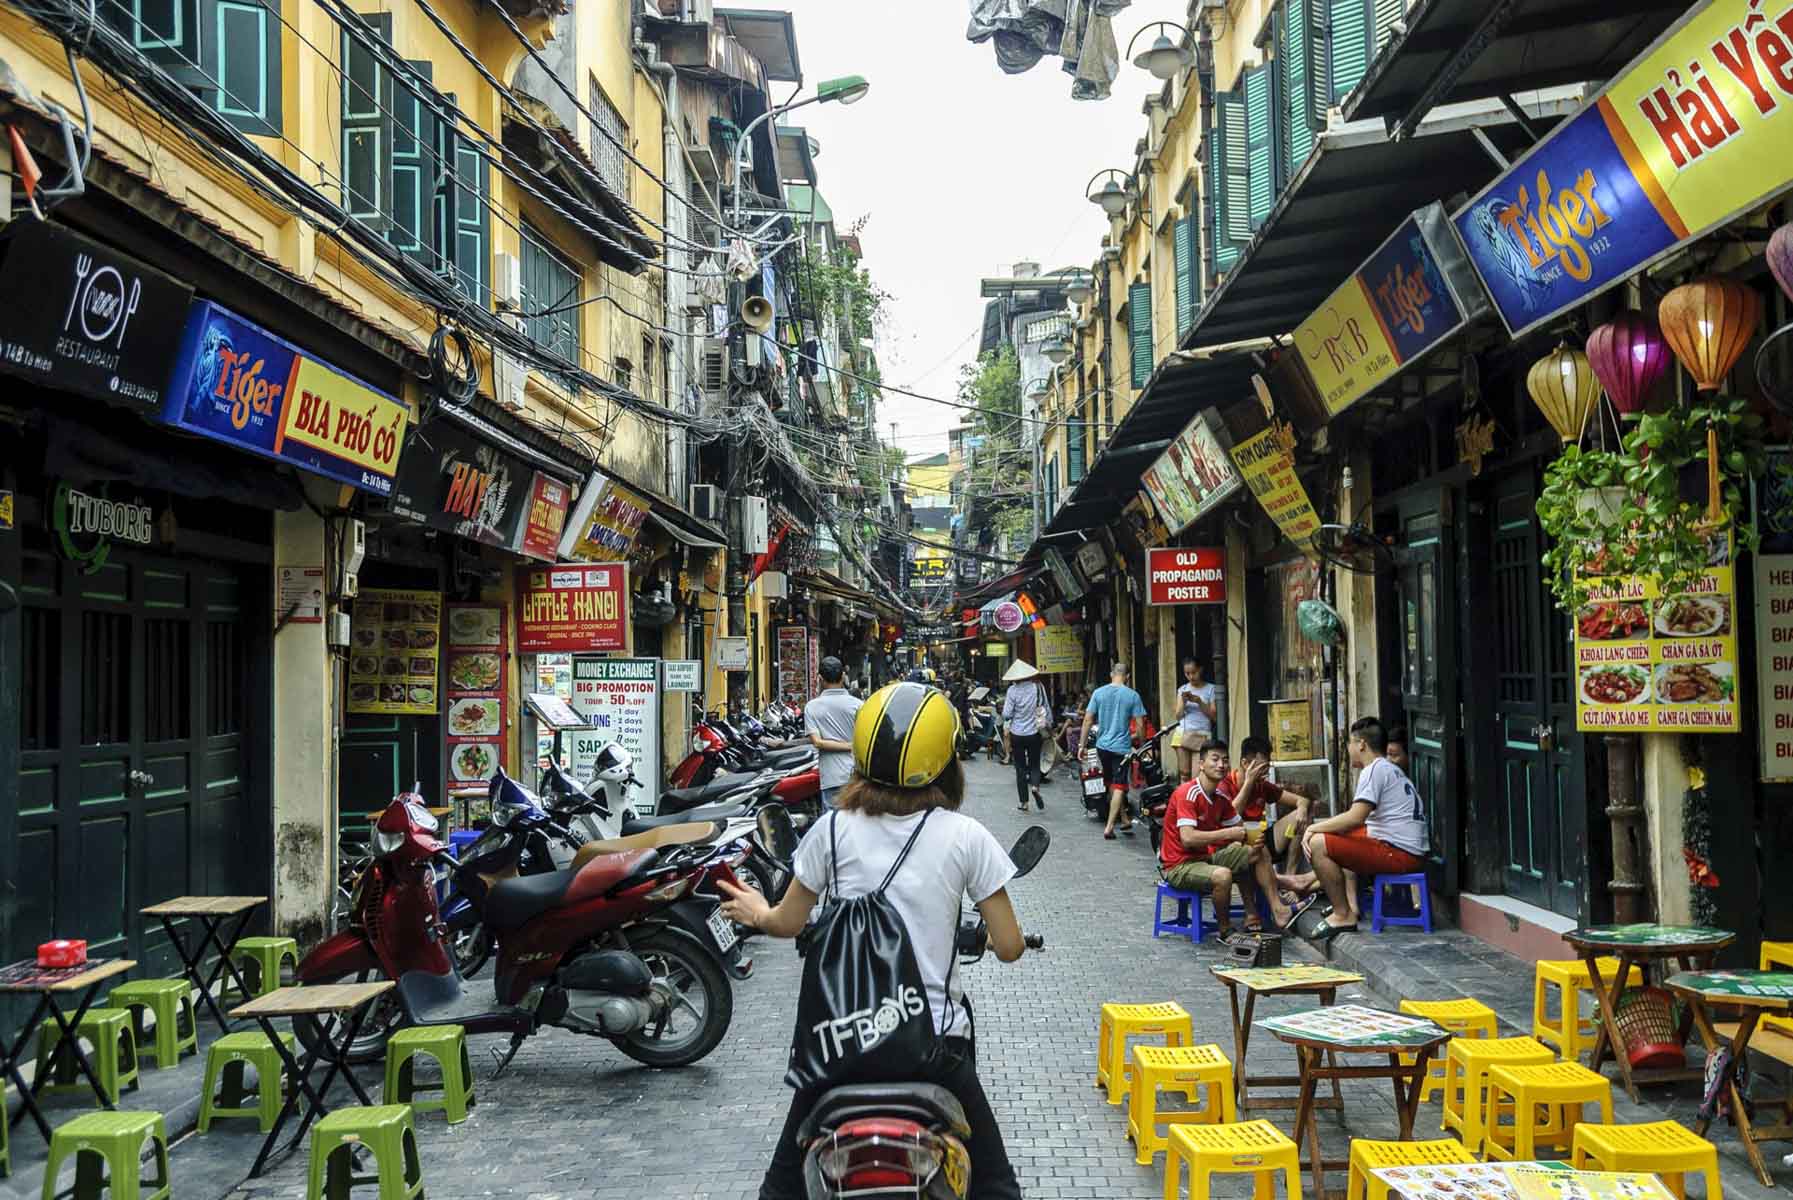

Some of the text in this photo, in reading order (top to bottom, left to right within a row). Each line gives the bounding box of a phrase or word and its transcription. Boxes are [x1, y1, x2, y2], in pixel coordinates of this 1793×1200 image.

[1639, 62, 1742, 168] Hải
[1497, 168, 1613, 282] Tiger
[1376, 264, 1432, 334] Tiger
[55, 336, 120, 372] RESTAURANT
[214, 346, 281, 430] Tiger
[294, 389, 401, 464] BIA PHỐ CỔ
[68, 489, 152, 543] TUBORG
[1175, 553, 1198, 566] OLD
[1153, 568, 1223, 583] PROPAGANDA
[1769, 569, 1793, 586] HE
[1168, 586, 1209, 600] POSTER
[523, 590, 619, 623] LITTLE HANOI
[1580, 647, 1603, 662] KHOAI
[1605, 647, 1625, 660] LANG
[576, 662, 654, 678] MONEY EXCHANGE
[576, 683, 654, 692] BIG PROMOTION
[1775, 685, 1793, 700] BI
[624, 708, 639, 716] day
[624, 717, 643, 726] days
[1775, 713, 1793, 728] BI
[624, 727, 643, 735] days
[1776, 743, 1793, 757] BI
[813, 984, 925, 1064] TFBOYS
